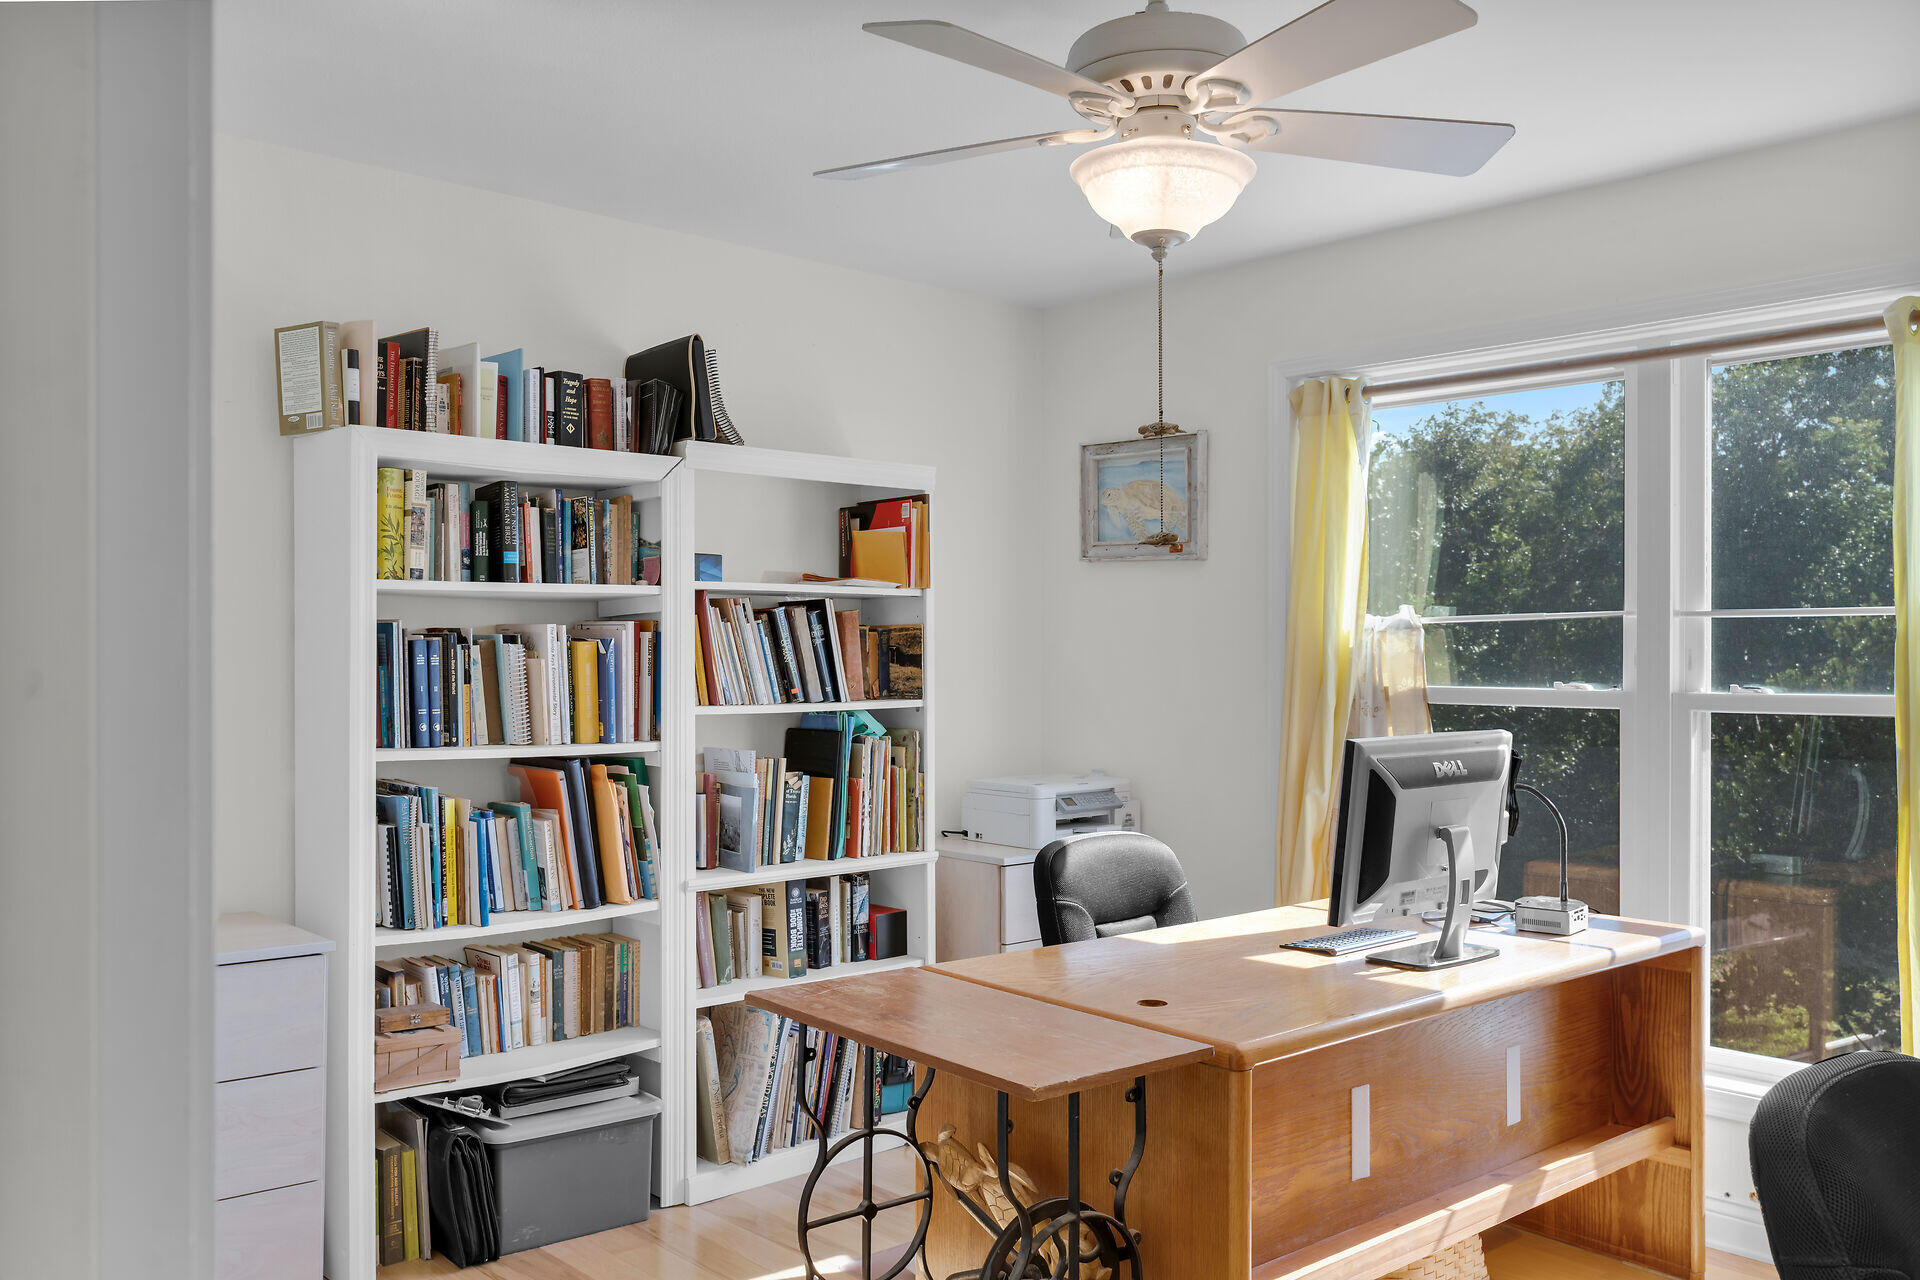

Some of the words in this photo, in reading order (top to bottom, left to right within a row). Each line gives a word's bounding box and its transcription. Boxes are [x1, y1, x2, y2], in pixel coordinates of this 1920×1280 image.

[562, 378, 580, 388] Tragedy
[565, 396, 578, 405] Hope
[510, 508, 517, 516] OF
[1432, 760, 1468, 778] DELL
[764, 1064, 775, 1094] WORLD
[760, 1094, 769, 1118] ATLAS
